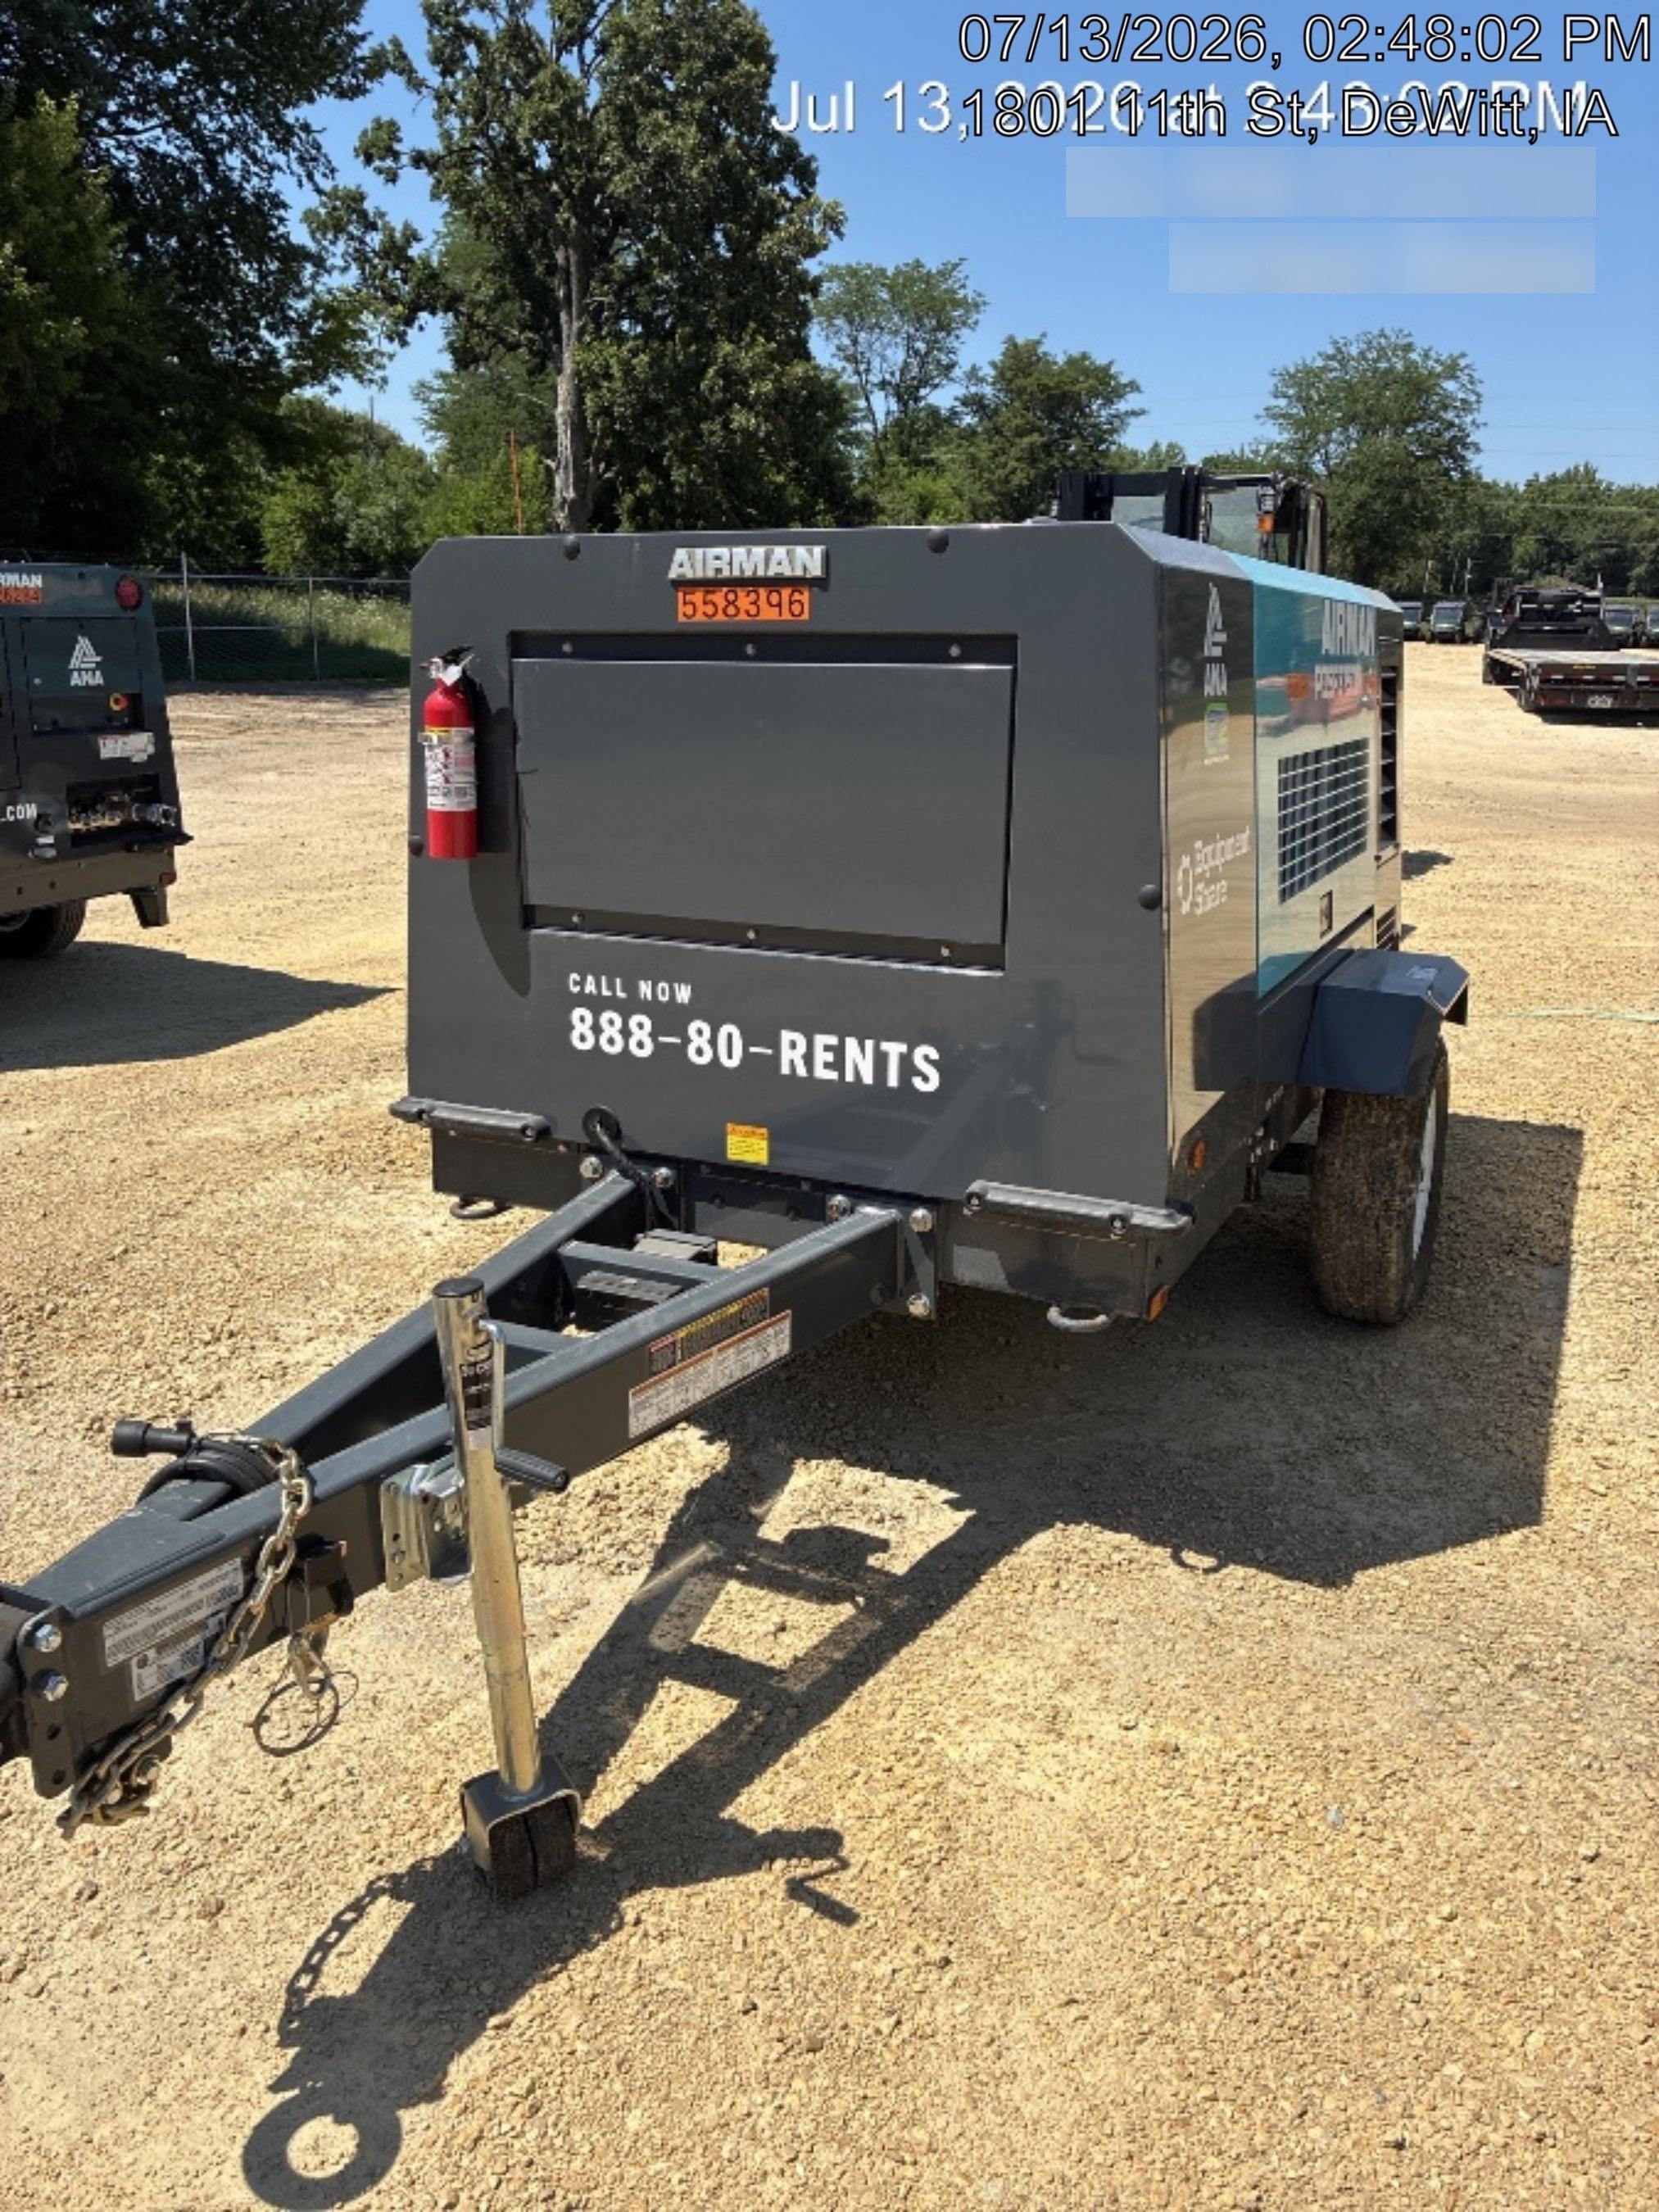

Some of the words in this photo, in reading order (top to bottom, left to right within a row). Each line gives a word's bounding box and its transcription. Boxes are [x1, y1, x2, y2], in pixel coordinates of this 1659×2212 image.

[668, 546, 827, 578] AIRMAN
[682, 589, 805, 619] 558396
[1204, 663, 1227, 696] ANA
[1194, 879, 1227, 915] Share
[569, 972, 628, 999] CALL
[638, 981, 692, 1004] NOW
[570, 1007, 941, 1093] 888-80-RENTS
